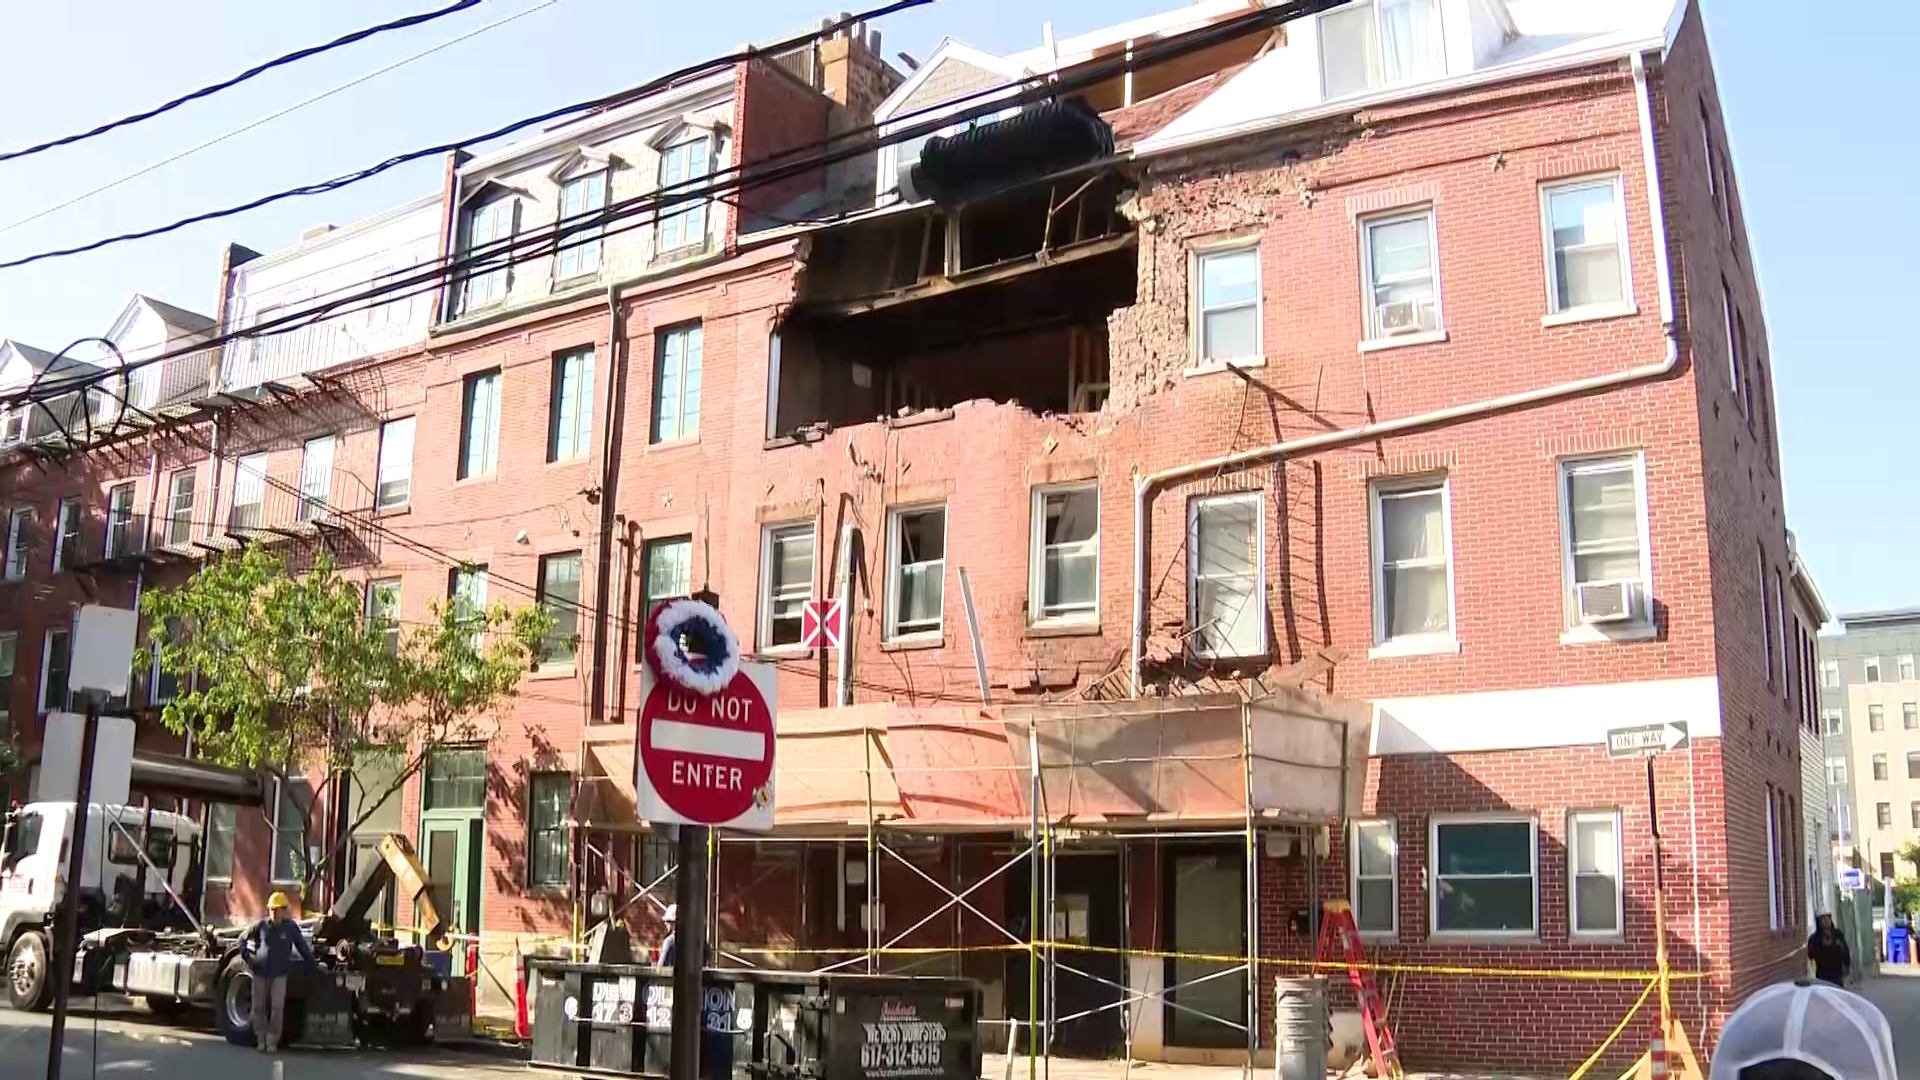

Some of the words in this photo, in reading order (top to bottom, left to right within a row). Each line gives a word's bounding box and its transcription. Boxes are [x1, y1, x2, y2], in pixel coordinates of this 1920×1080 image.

[667, 692, 697, 714] DO
[711, 697, 752, 722] NOT
[1616, 733, 1637, 747] ONE
[1641, 731, 1662, 746] WAY
[672, 760, 742, 791] ENTER
[861, 1041, 941, 1068] 617-312-6315
